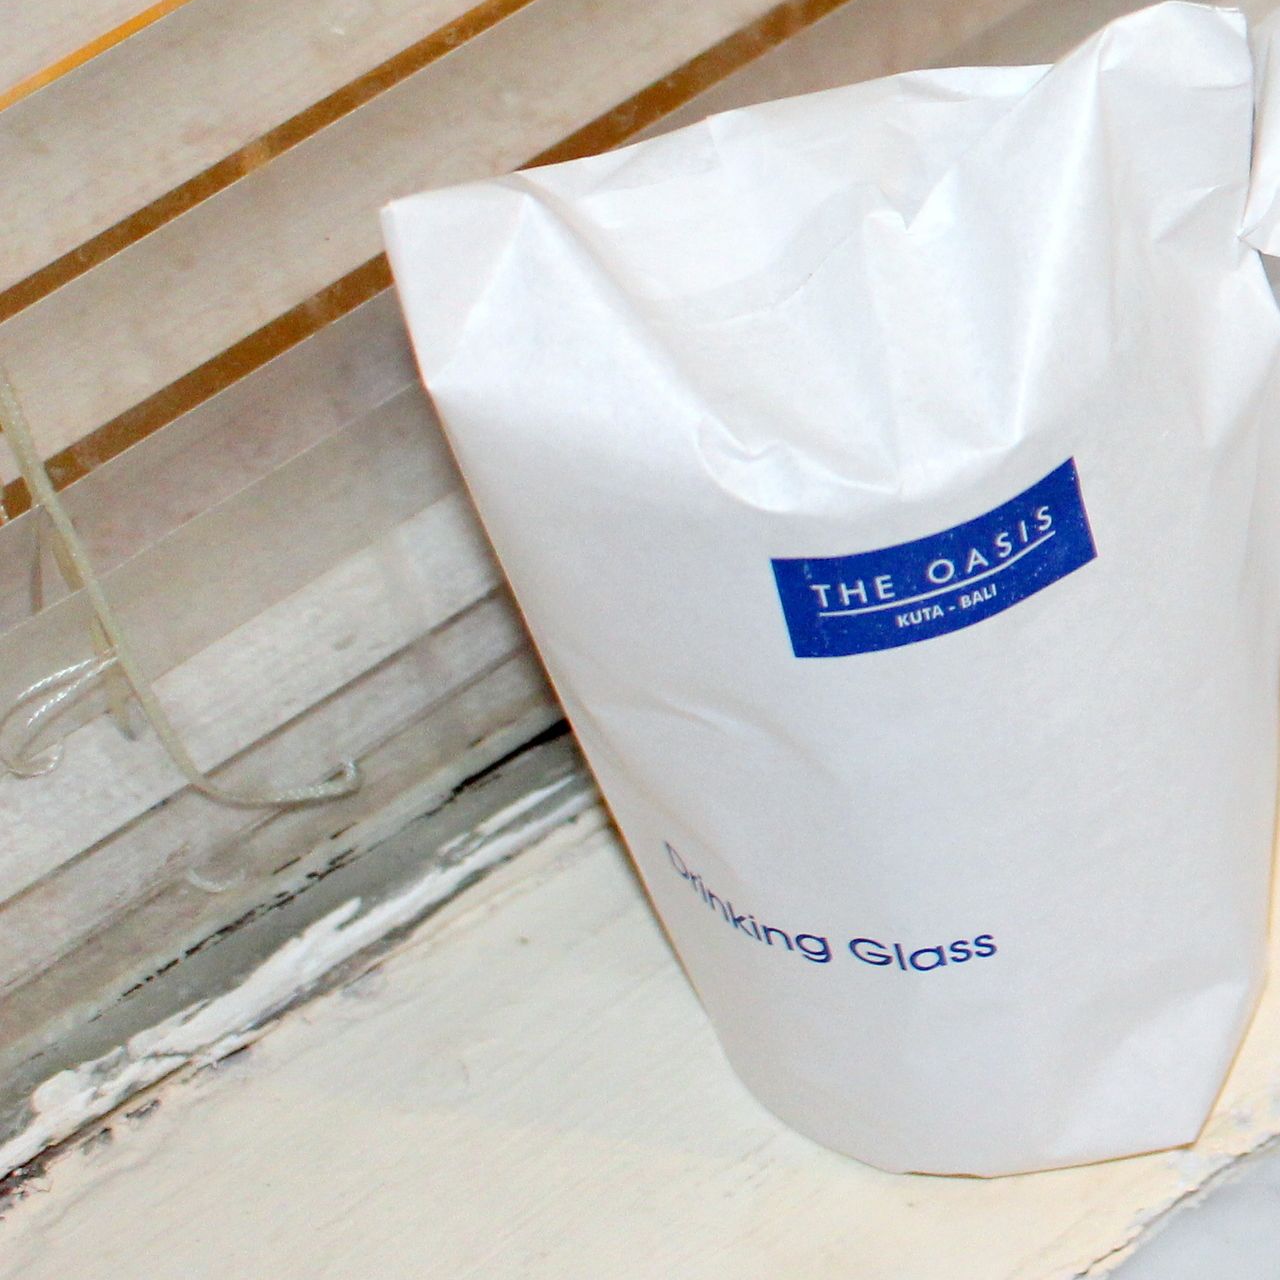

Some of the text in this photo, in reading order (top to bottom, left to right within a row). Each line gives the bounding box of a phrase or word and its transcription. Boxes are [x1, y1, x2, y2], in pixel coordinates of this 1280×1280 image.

[809, 505, 1054, 609] THE OASIS
[897, 605, 945, 629] KUTA
[959, 584, 998, 611] BALI
[849, 934, 998, 972] Glass
